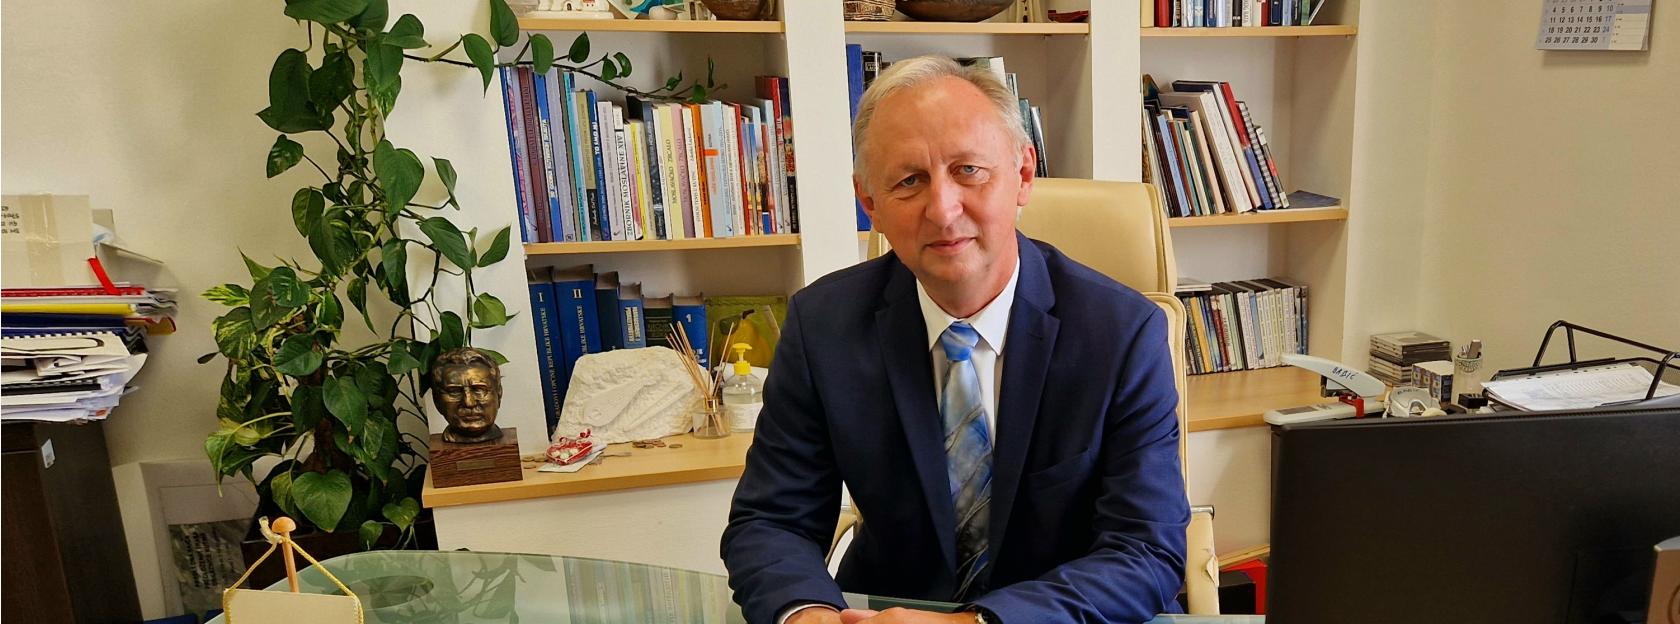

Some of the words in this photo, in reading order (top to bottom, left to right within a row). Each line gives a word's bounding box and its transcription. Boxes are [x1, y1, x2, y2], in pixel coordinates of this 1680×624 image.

[591, 121, 598, 130] MI
[594, 146, 600, 154] TO
[616, 134, 624, 150] XIV
[677, 138, 685, 161] ZRCALO
[618, 151, 630, 197] MOSLAVINE
[668, 166, 678, 204] MOSLAVAČKO
[624, 200, 633, 236] ZBORNIK
[538, 292, 544, 302] I
[573, 288, 582, 299] II
[540, 306, 549, 336] HRVATSKE
[576, 304, 585, 334] HRVATSKE
[686, 314, 692, 322] 1
[545, 336, 554, 367] REPUBLIKE
